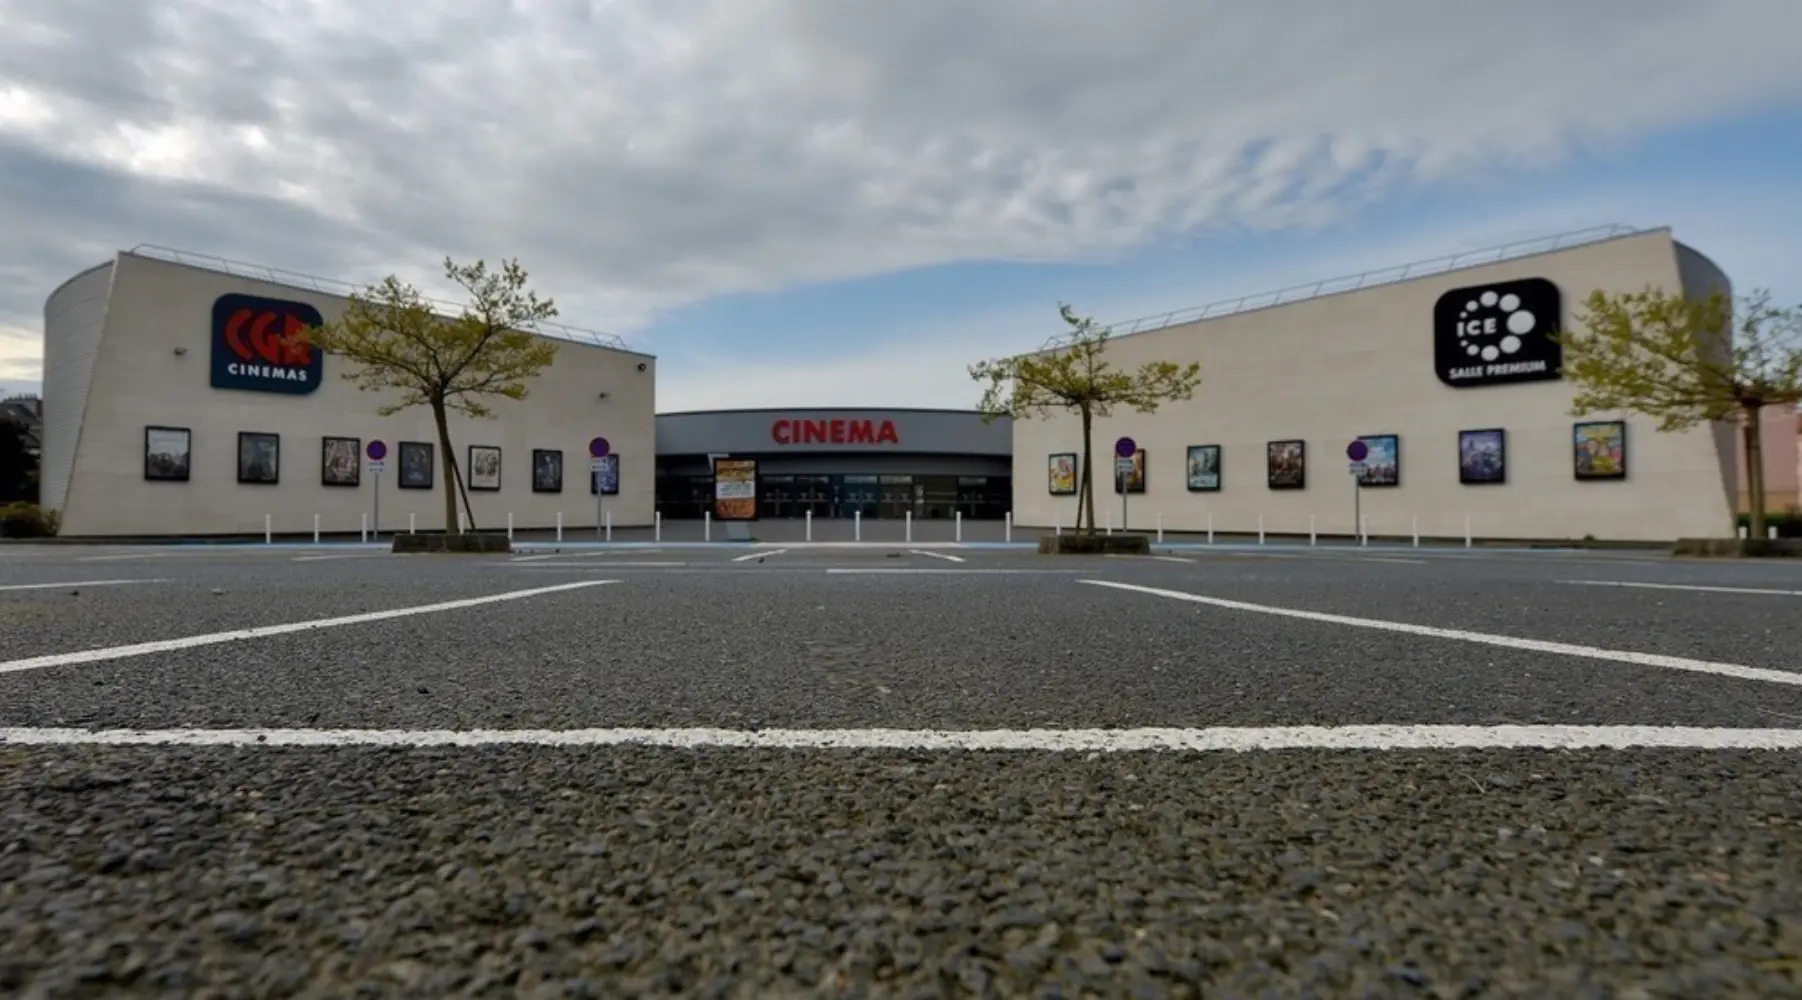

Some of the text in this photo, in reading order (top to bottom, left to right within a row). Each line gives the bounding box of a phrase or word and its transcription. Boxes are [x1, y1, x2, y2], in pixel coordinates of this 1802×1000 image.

[225, 308, 312, 365] CGR
[1456, 318, 1497, 337] ICE
[227, 363, 308, 382] CINEMAS
[1448, 360, 1546, 380] SALLE PREMIUM
[771, 418, 899, 445] CINEMA
